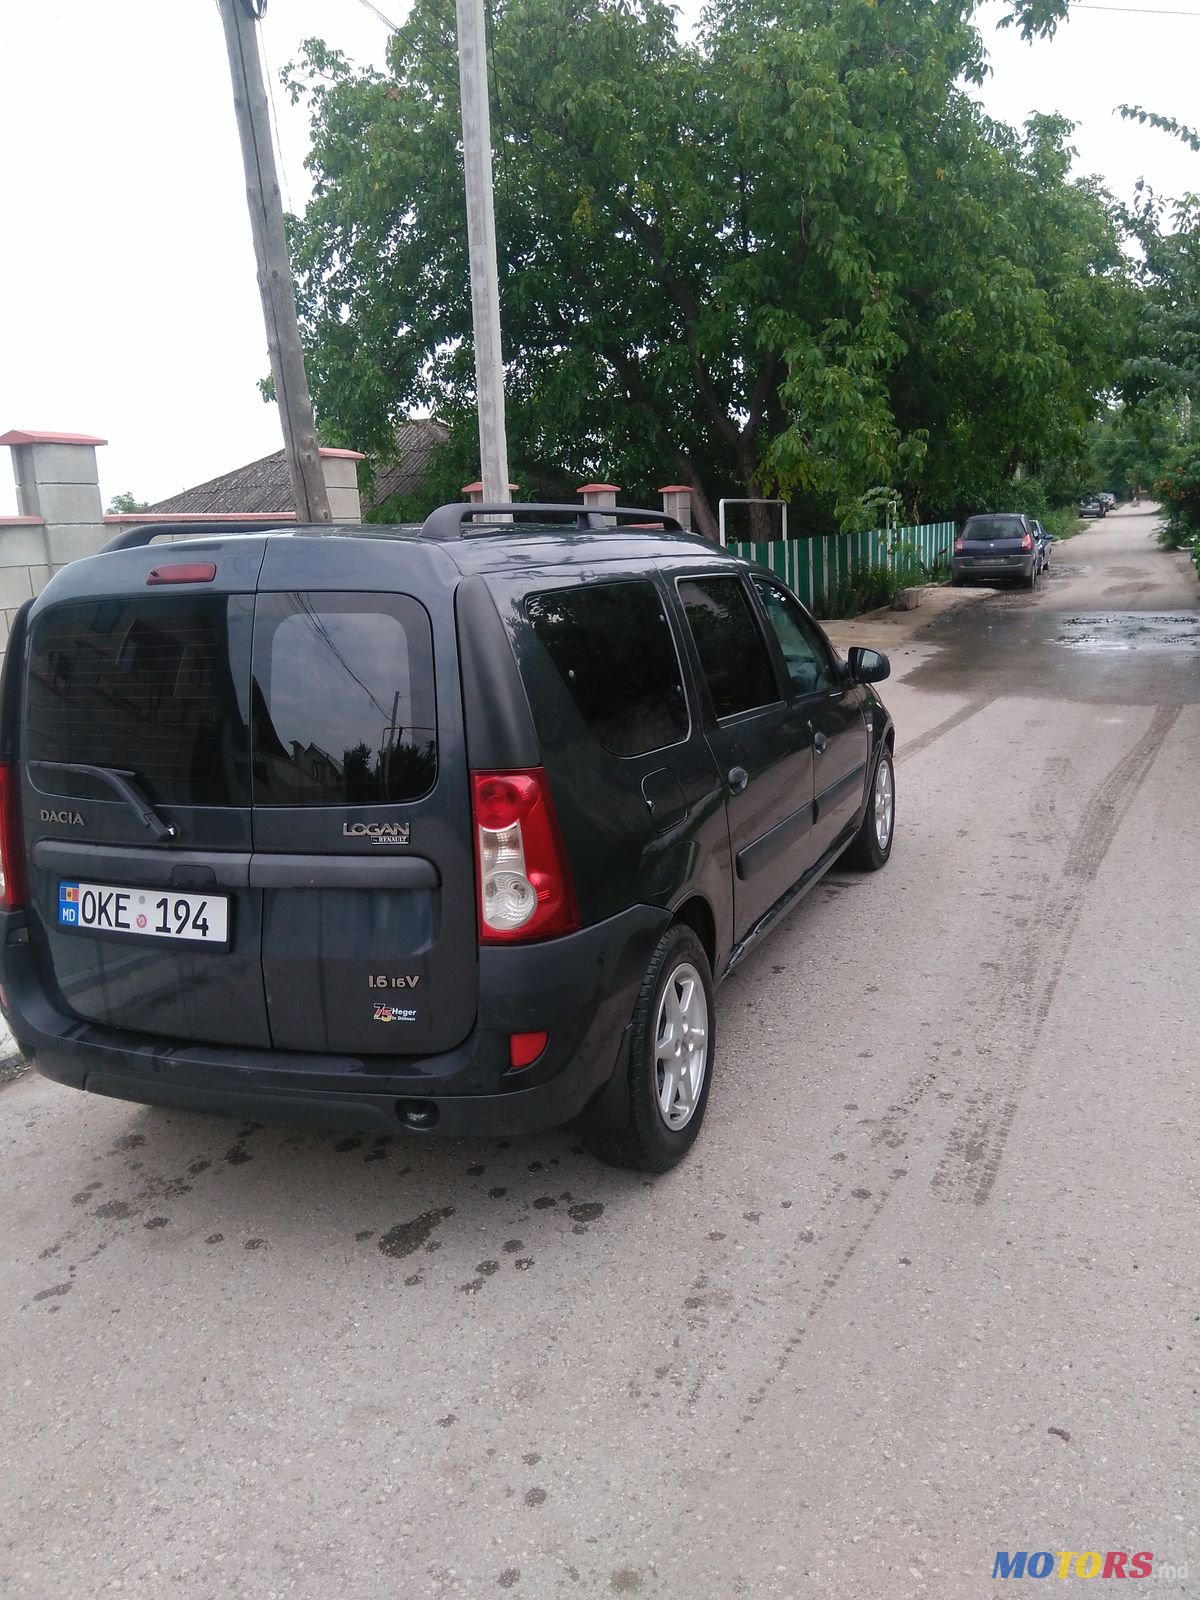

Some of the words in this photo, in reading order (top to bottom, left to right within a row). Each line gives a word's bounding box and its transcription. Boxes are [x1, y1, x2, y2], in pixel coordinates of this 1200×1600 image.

[40, 809, 85, 826] DACIA
[342, 822, 410, 836] LOGAN
[62, 908, 76, 922] MD
[81, 890, 131, 929] OKE
[155, 897, 209, 937] 194
[368, 975, 388, 988] 1.6
[391, 975, 420, 988] 16V
[373, 1002, 393, 1022] 75
[391, 1007, 417, 1017] Heger
